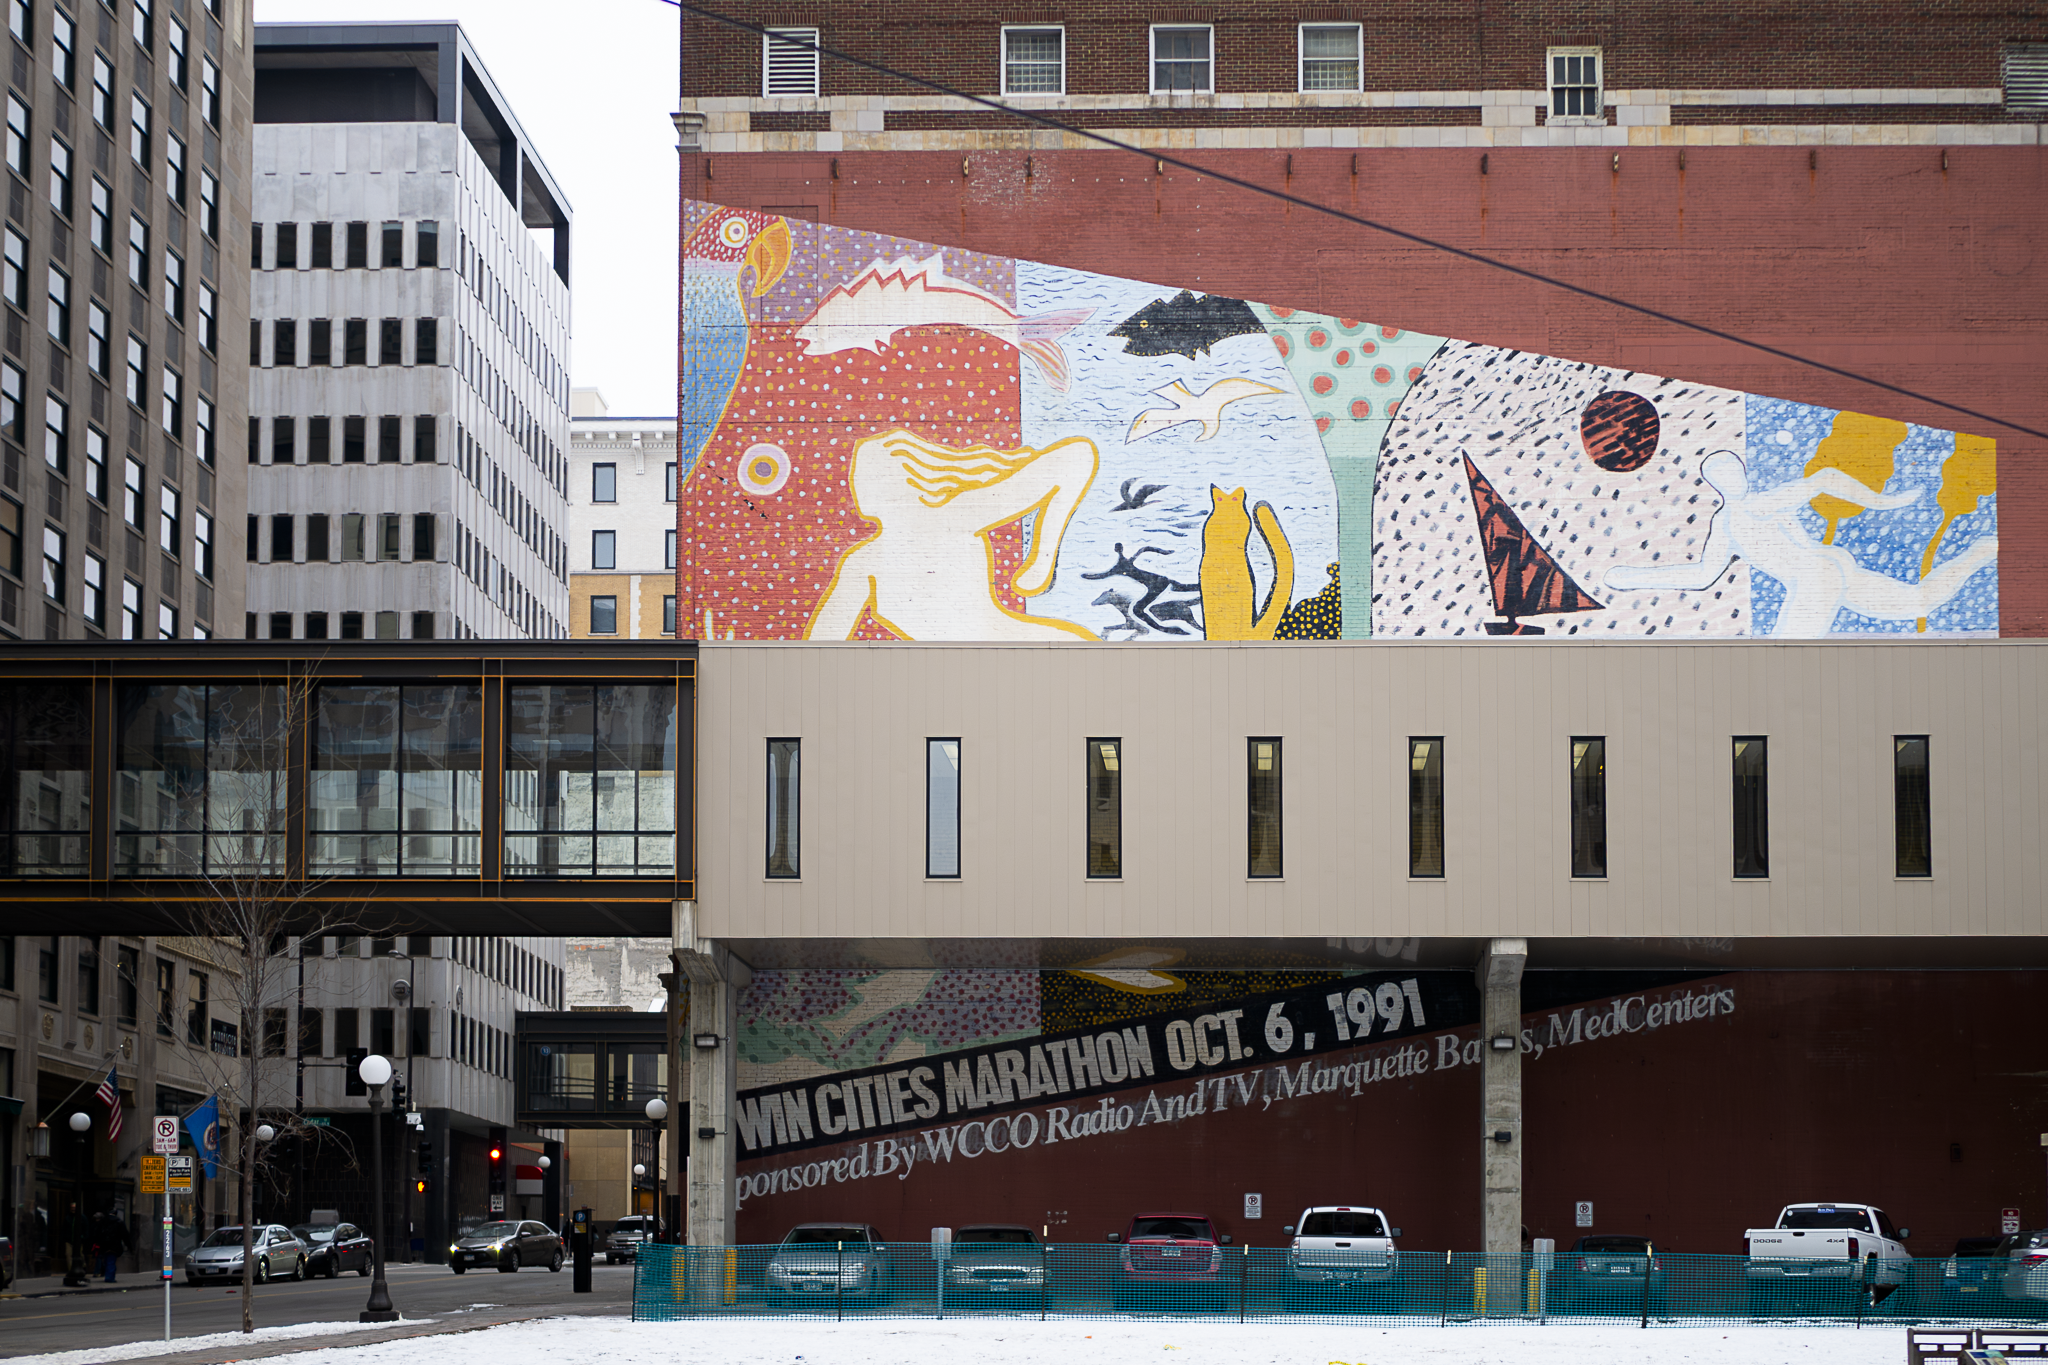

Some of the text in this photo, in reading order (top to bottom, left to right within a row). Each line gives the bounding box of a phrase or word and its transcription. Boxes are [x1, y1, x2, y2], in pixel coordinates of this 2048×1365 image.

[736, 1088, 814, 1150] WIN
[815, 1066, 940, 1136] CITIES
[943, 1025, 1154, 1113] MARATHON
[1165, 1009, 1254, 1070] OCT.
[1326, 978, 1425, 1041] 1991
[736, 1142, 869, 1210] ponsored
[873, 1139, 917, 1180] By
[920, 1112, 1039, 1163] WCCO
[1045, 1097, 1134, 1145] Radio
[1137, 1078, 1206, 1127] And
[1273, 1044, 1429, 1097] Marquette
[1434, 1028, 1544, 1071] Bas,
[1547, 988, 1735, 1049] MedCenters
